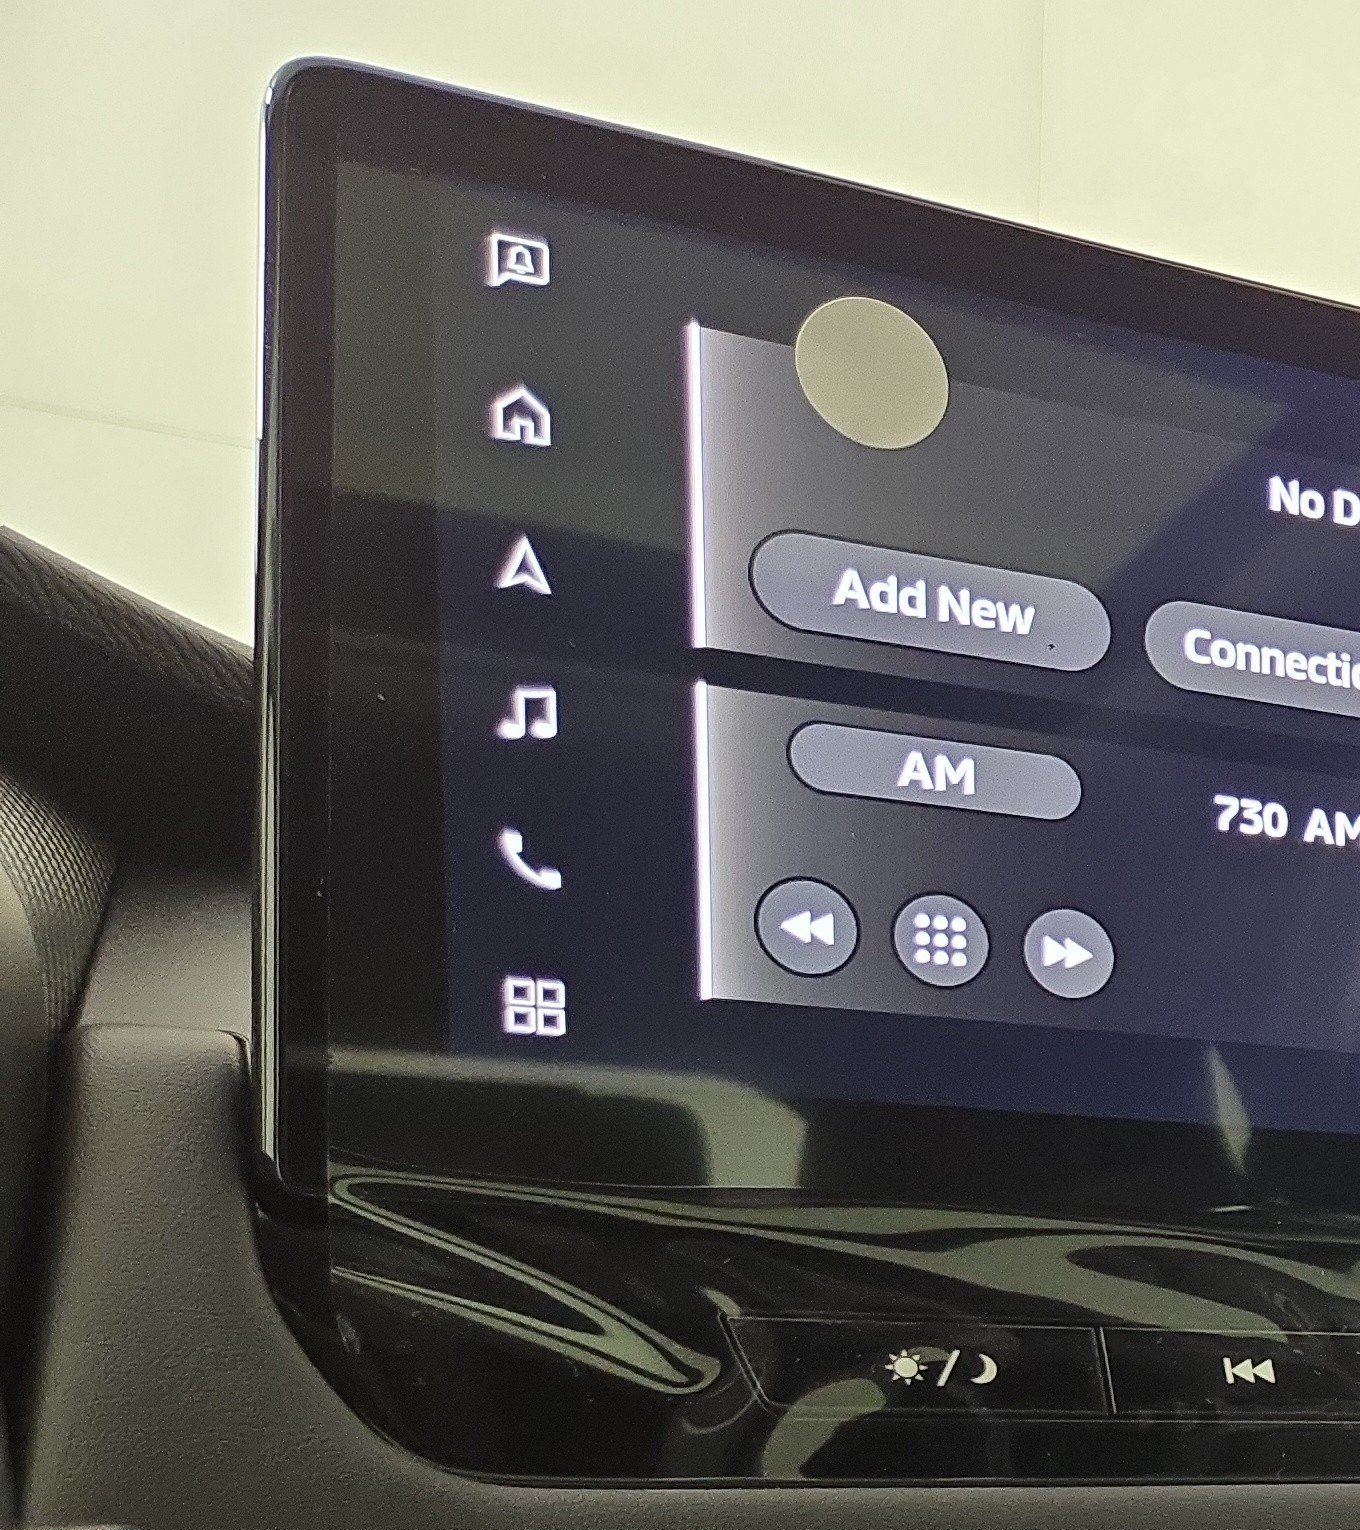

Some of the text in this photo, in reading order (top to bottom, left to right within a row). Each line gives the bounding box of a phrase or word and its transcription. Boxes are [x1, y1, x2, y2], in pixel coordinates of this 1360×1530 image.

[1268, 475, 1325, 519] No
[832, 568, 1036, 636] Add New
[897, 750, 975, 796] AM
[1213, 795, 1288, 839] 730
